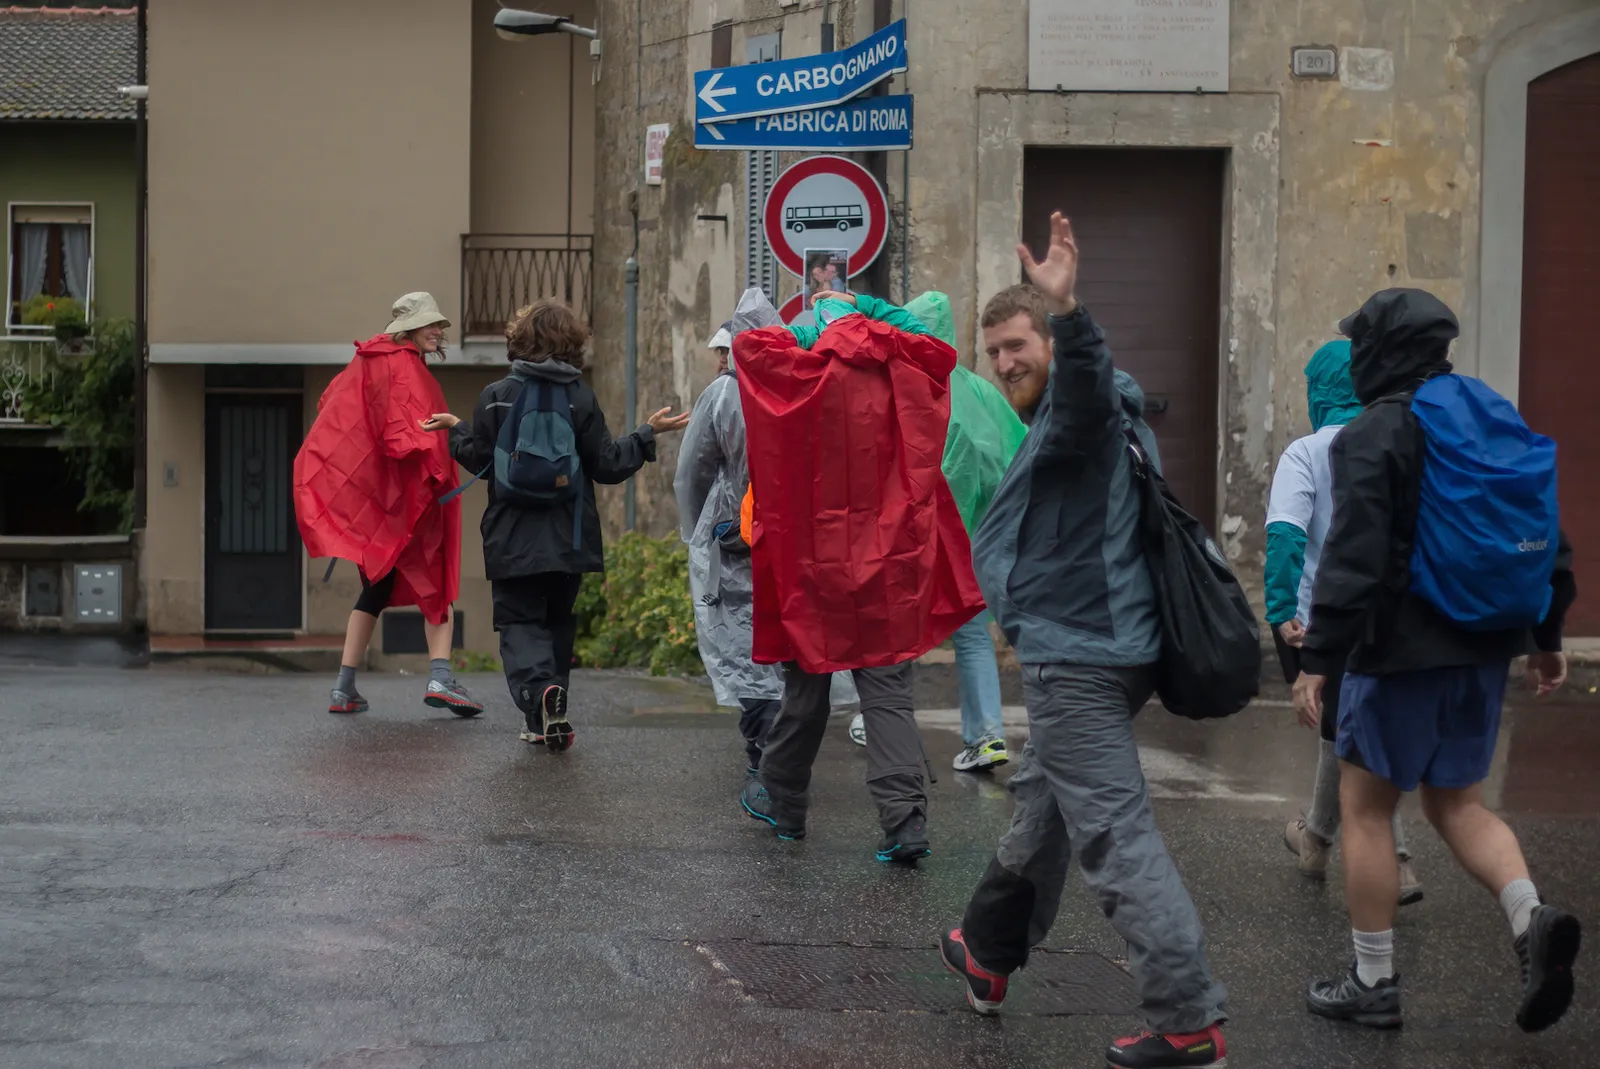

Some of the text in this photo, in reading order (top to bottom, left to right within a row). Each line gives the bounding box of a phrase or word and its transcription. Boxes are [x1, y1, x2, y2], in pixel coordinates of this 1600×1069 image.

[756, 35, 898, 97] CARBOGNANO
[1306, 56, 1323, 69] 20
[755, 108, 908, 133] FABRICA DI ROMA
